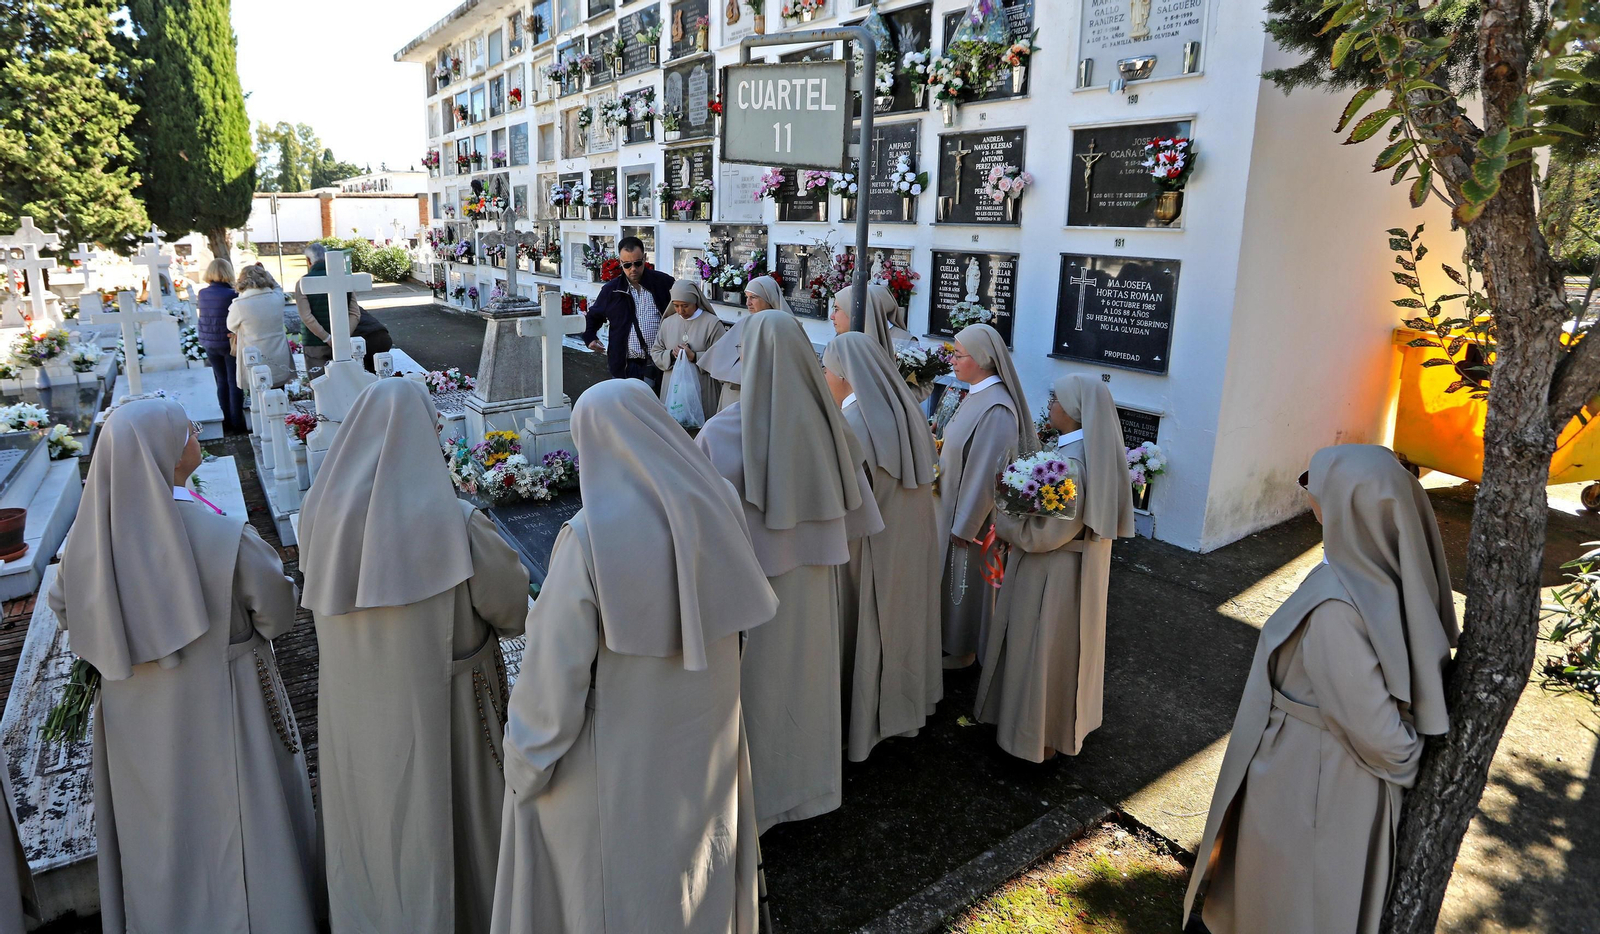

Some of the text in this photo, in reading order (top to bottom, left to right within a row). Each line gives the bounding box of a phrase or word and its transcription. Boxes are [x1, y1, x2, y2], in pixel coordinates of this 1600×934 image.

[1094, 6, 1119, 17] GALLO
[1157, 0, 1202, 14] SALGUERO
[1089, 14, 1125, 28] RAMIREZ
[1183, 18, 1199, 26] AÑOS
[1110, 39, 1131, 47] FAMILIA
[1154, 30, 1180, 39] OLVIDAN
[737, 78, 836, 112] CUARTEL
[1128, 94, 1138, 104] 190
[773, 122, 792, 153] 11
[888, 142, 912, 151] AMPARO
[1110, 149, 1137, 158] OCAÑA
[1115, 238, 1125, 247] 191
[1121, 280, 1152, 290] JOSEFA
[1096, 289, 1163, 302] HORTAS ROMAN
[1111, 300, 1140, 309] OCTUBRE
[1131, 310, 1150, 318] AÑOS
[1095, 315, 1128, 324] HERMANA
[1136, 319, 1168, 329] SOBRINOS
[1110, 324, 1119, 332] LA
[1121, 326, 1150, 335] OLVIDAN
[1104, 349, 1140, 361] PROPIEDAD
[1125, 434, 1145, 443] PEREZ
